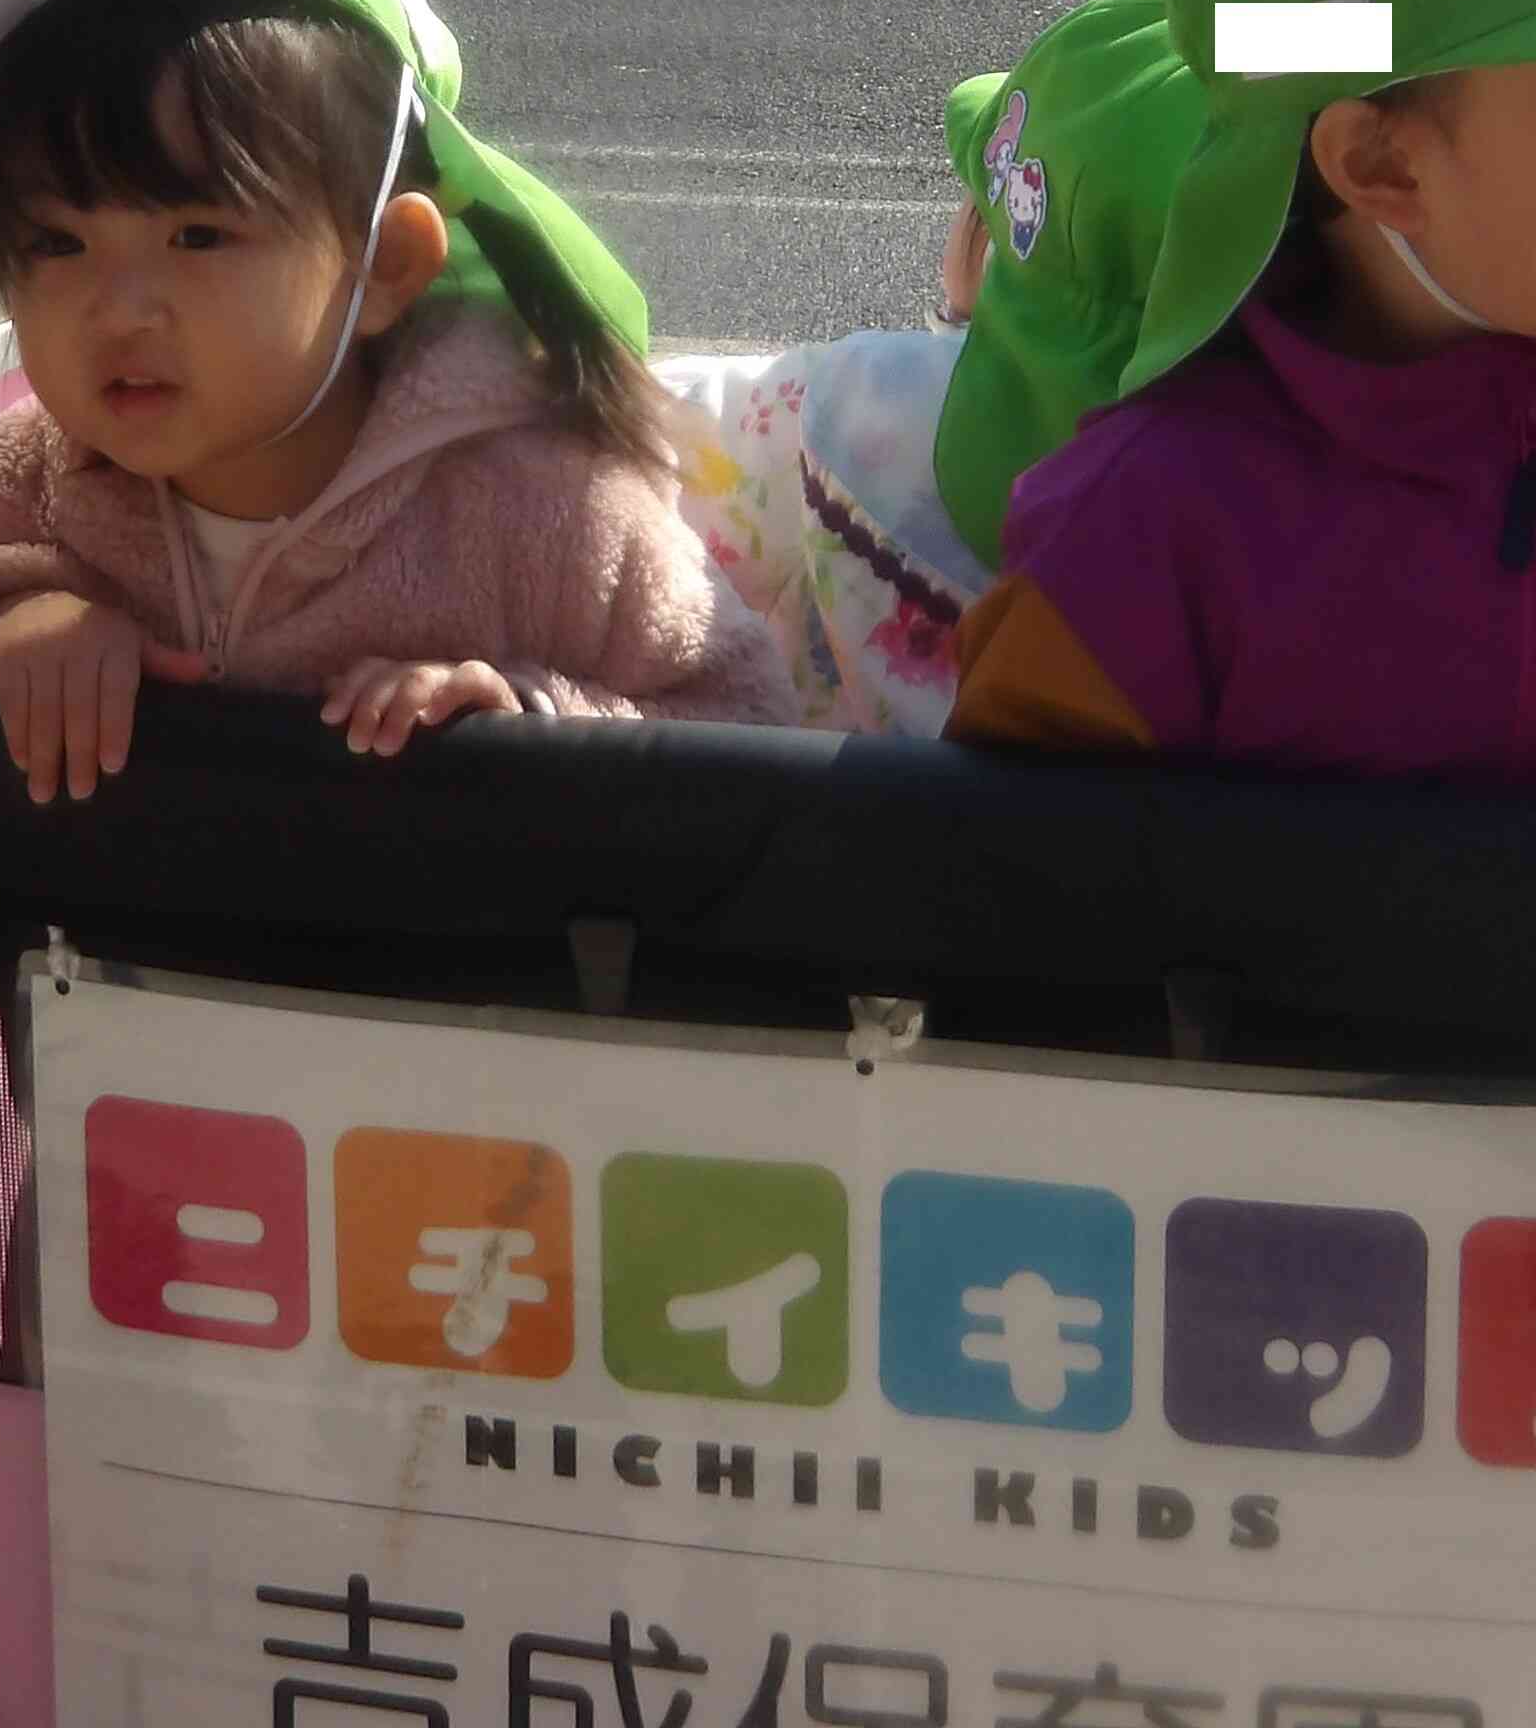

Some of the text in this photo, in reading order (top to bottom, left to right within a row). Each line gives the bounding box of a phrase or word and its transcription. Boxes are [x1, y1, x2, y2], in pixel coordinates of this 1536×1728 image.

[465, 1414, 1280, 1548] NICHII KIDS
[256, 1574, 1484, 1728] 吉成保
